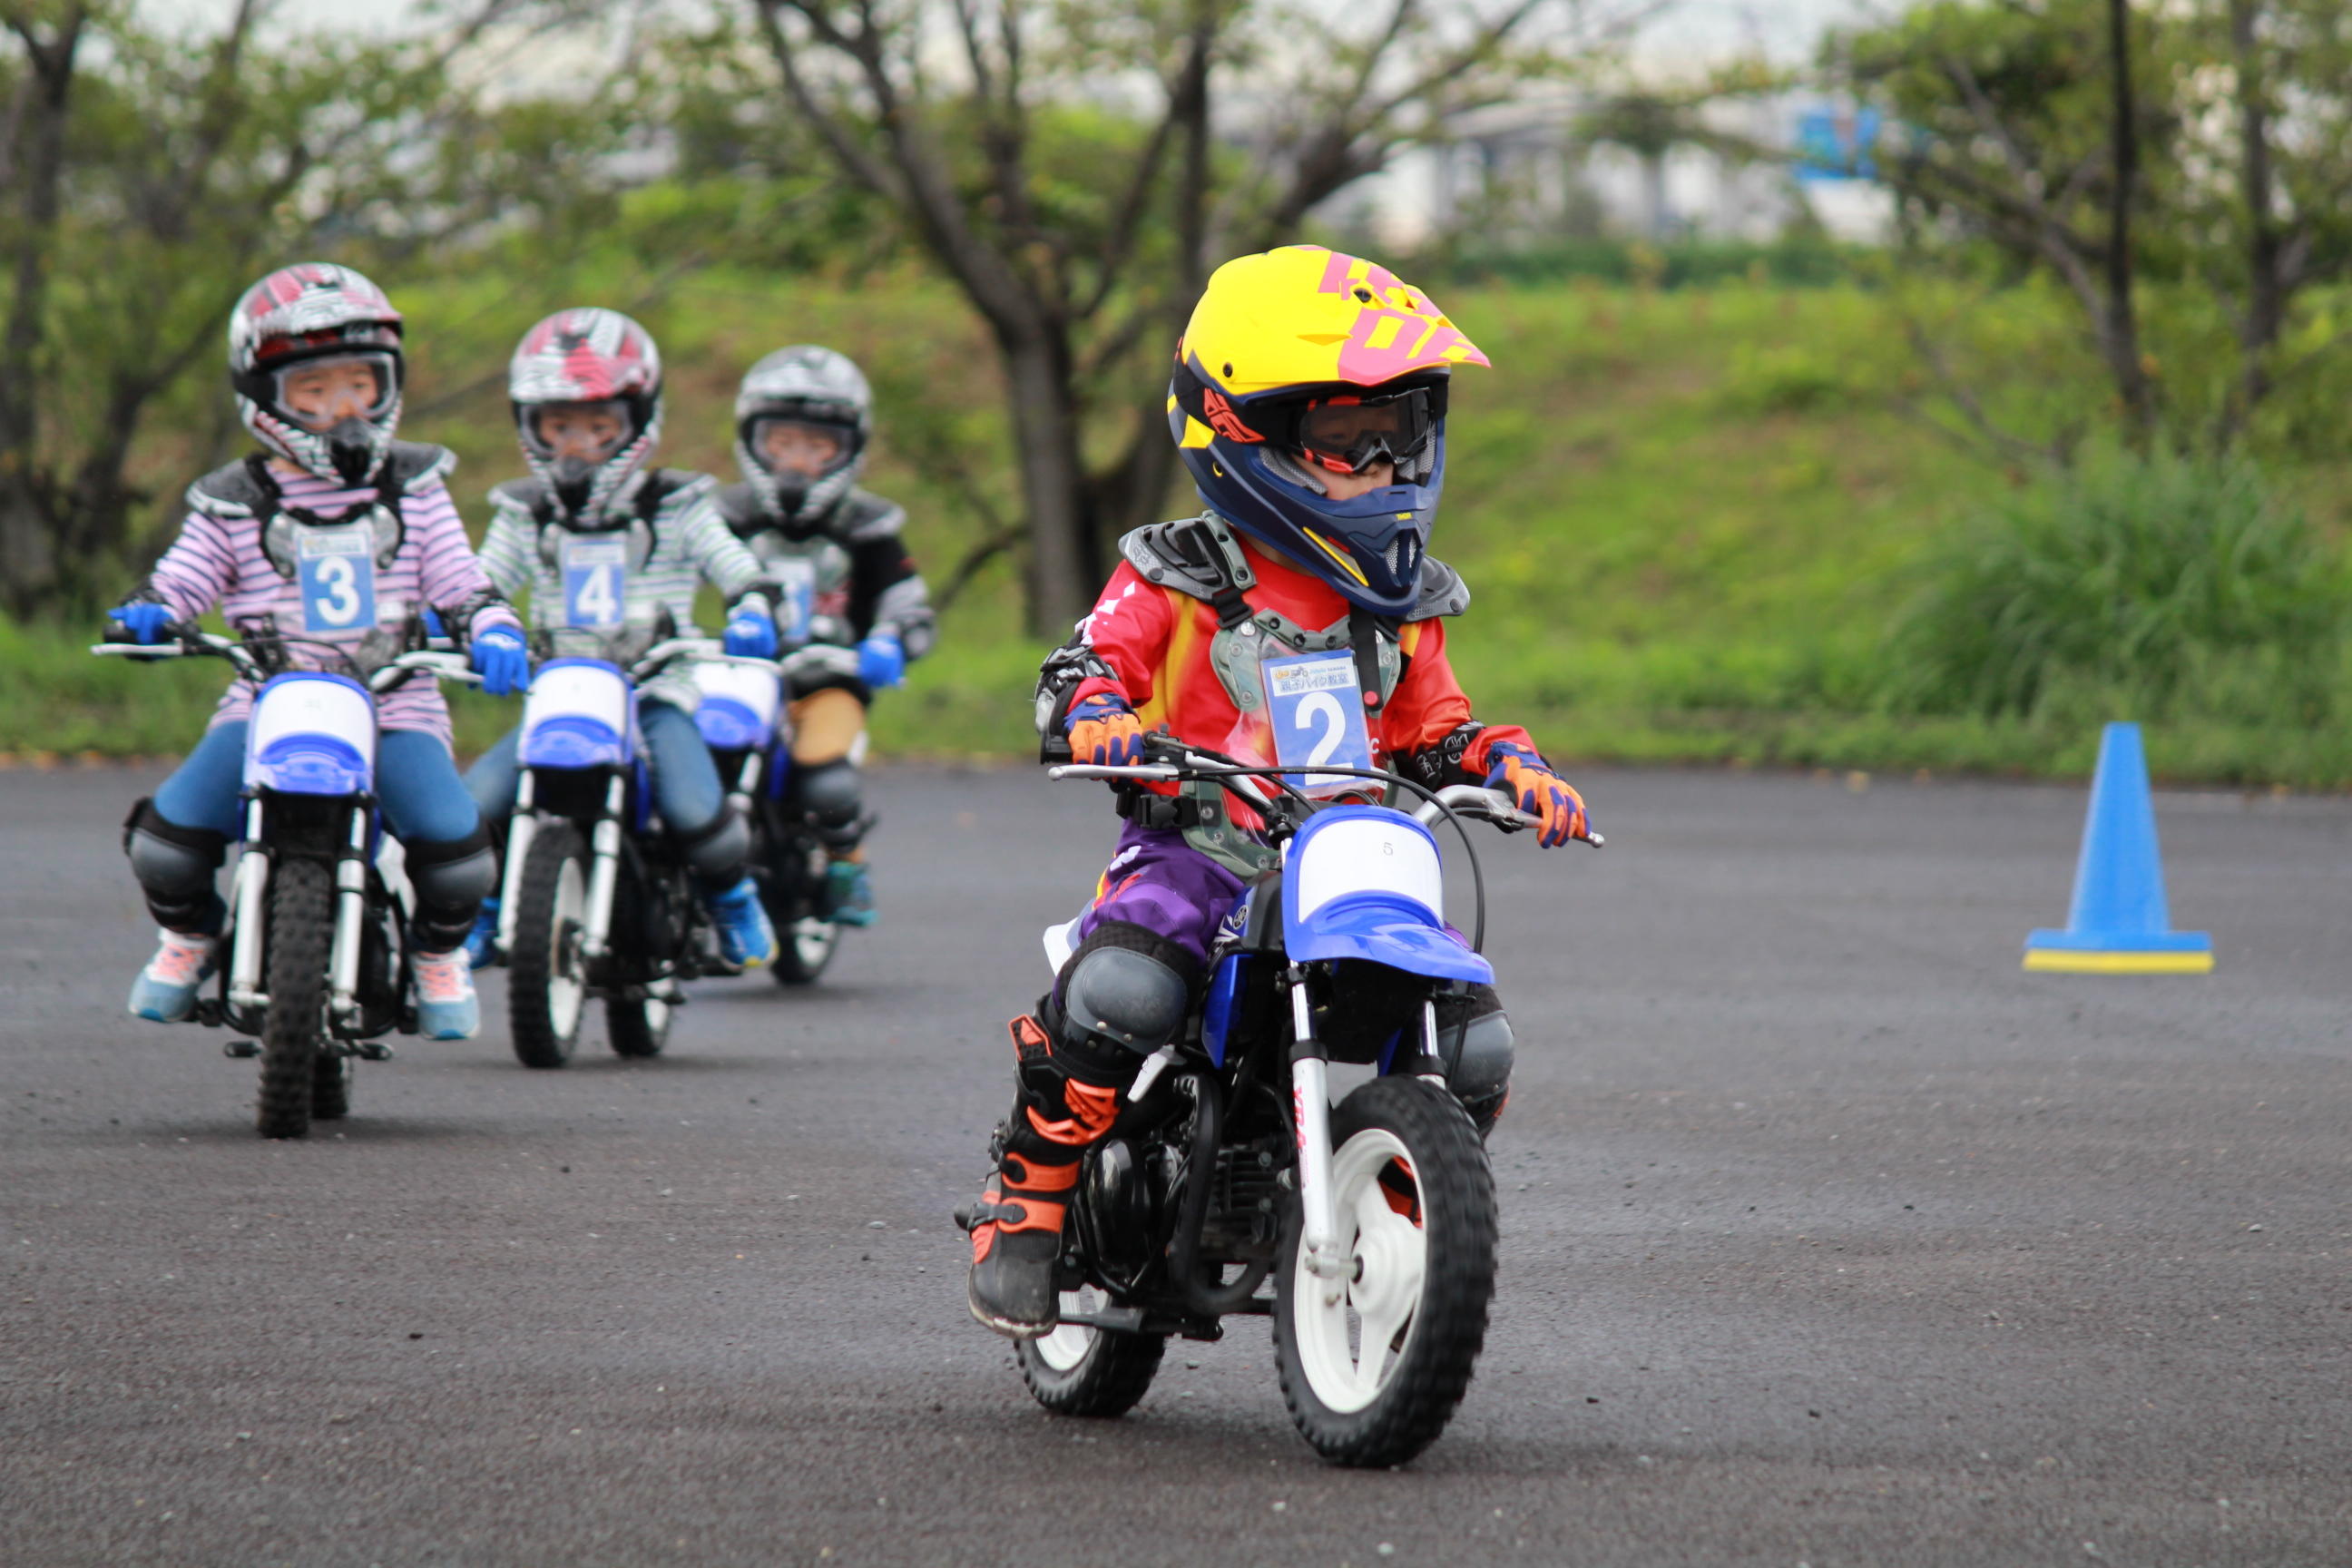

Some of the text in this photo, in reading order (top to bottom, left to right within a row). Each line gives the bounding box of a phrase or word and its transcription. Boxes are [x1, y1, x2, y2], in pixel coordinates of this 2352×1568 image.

[316, 555, 360, 625] 3
[576, 563, 616, 623] 4
[1296, 691, 1355, 785] 2
